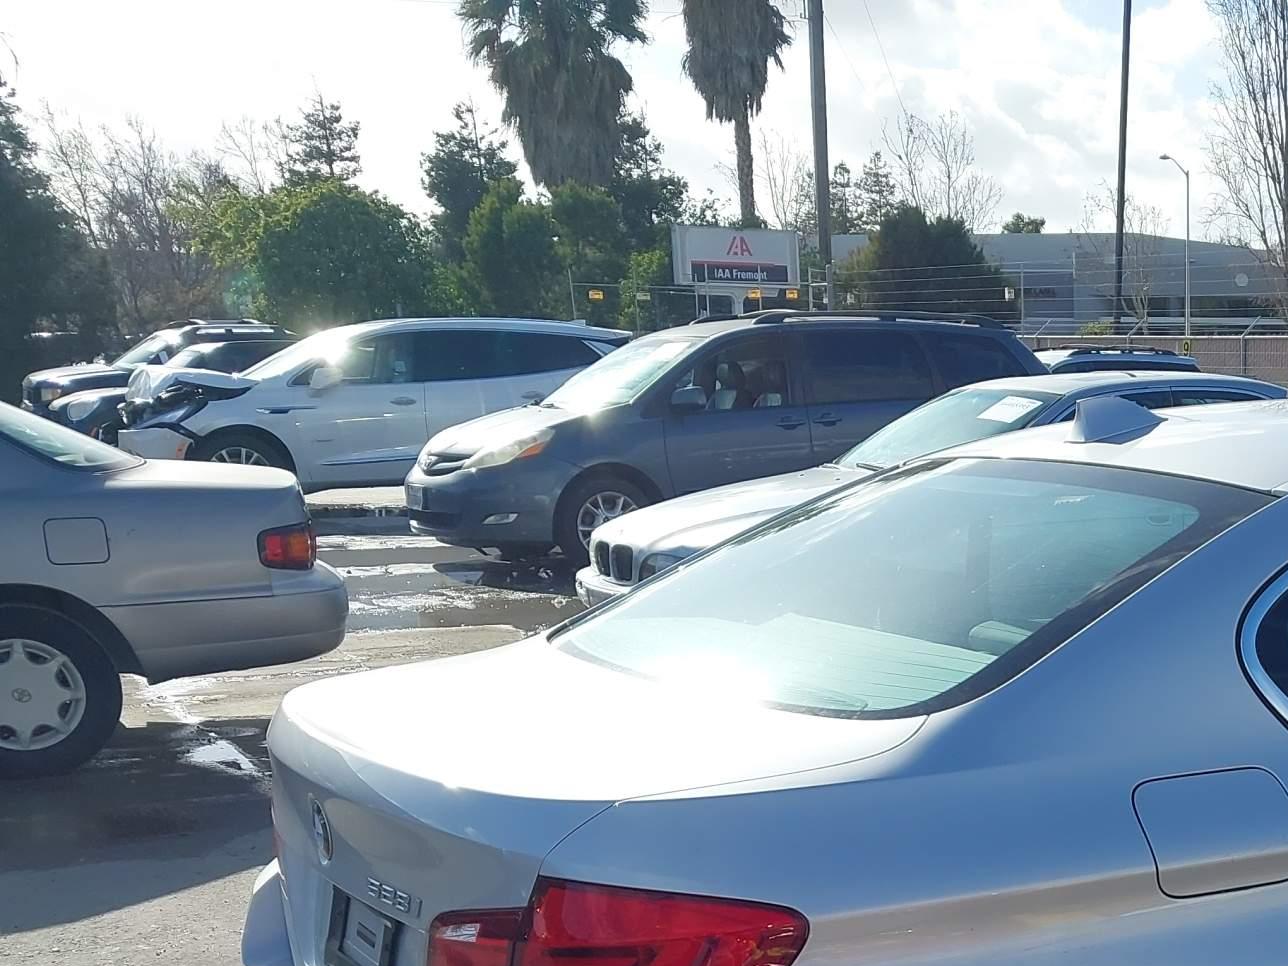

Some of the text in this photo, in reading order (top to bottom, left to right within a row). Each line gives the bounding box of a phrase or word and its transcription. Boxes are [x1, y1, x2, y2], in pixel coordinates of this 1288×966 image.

[714, 267, 768, 281] IAA Fremont
[1183, 341, 1190, 356] 9
